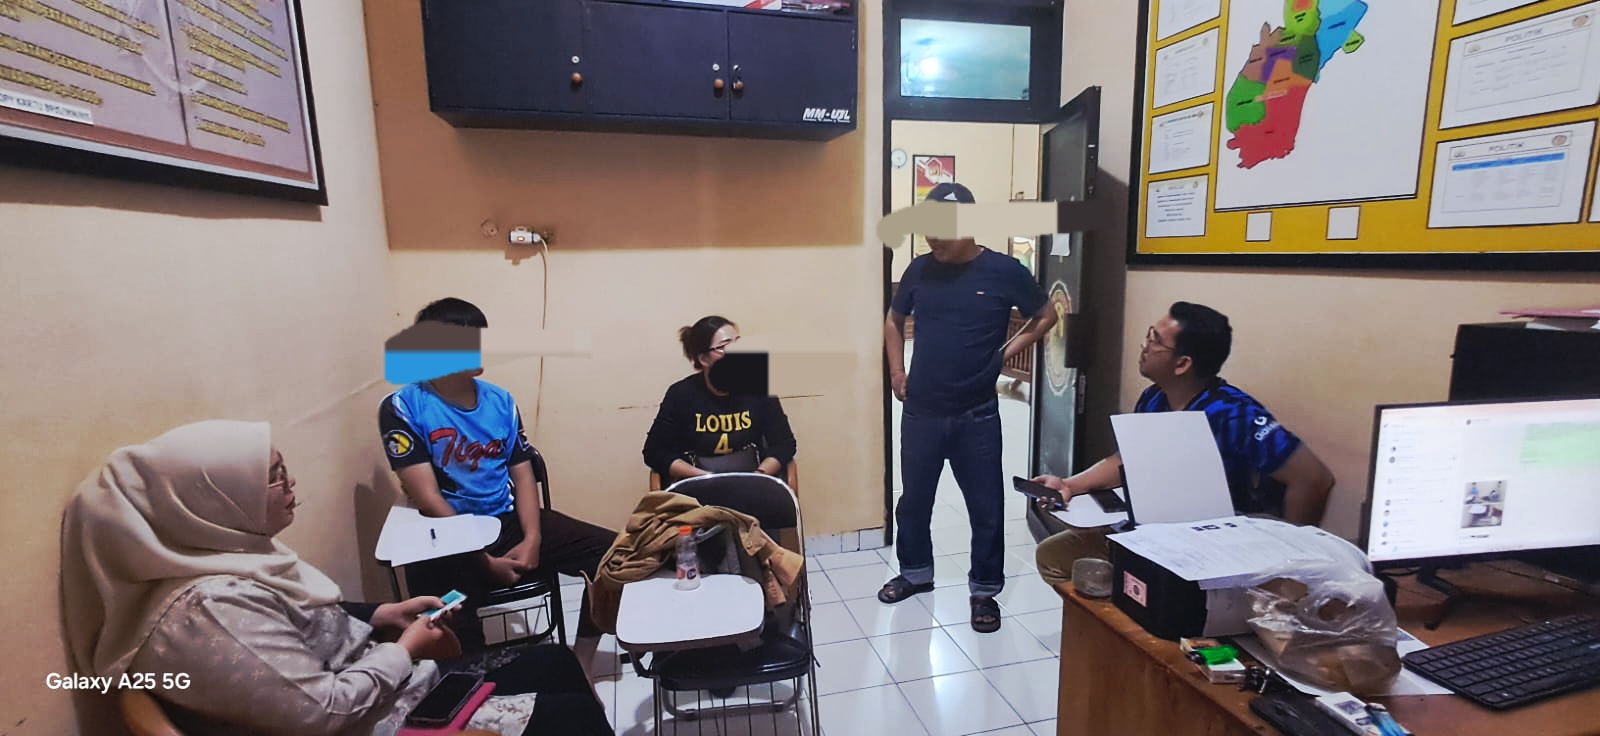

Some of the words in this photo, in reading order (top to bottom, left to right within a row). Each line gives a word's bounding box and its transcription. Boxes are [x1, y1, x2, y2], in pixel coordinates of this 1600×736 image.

[696, 411, 752, 432] LOUIS
[429, 427, 502, 472] Tiga
[714, 433, 733, 454] 4
